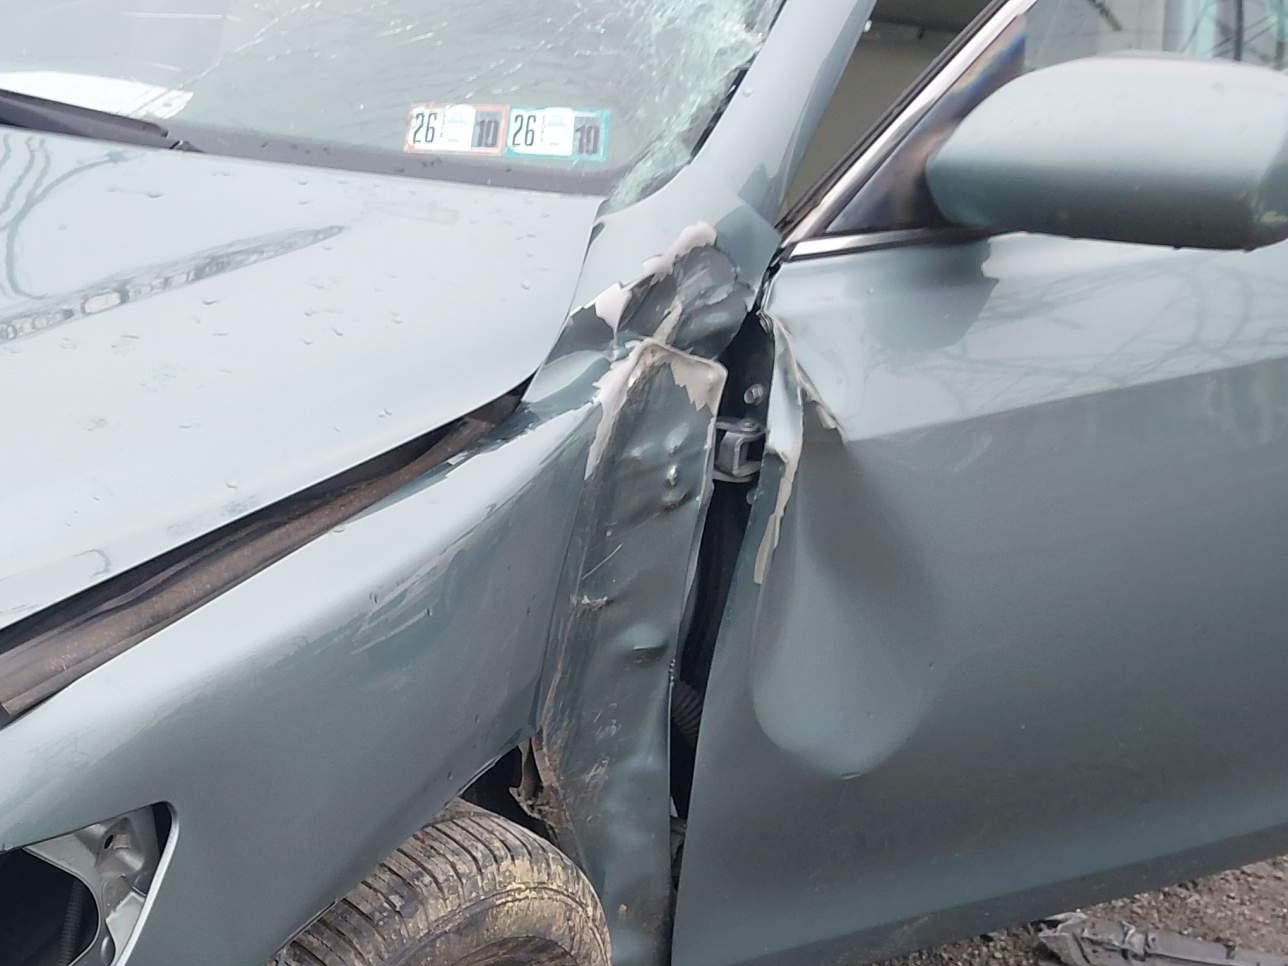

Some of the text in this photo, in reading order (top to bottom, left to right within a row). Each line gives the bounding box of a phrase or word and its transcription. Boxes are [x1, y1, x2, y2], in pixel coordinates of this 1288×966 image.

[413, 113, 499, 148] 26 10
[512, 114, 536, 146] 26
